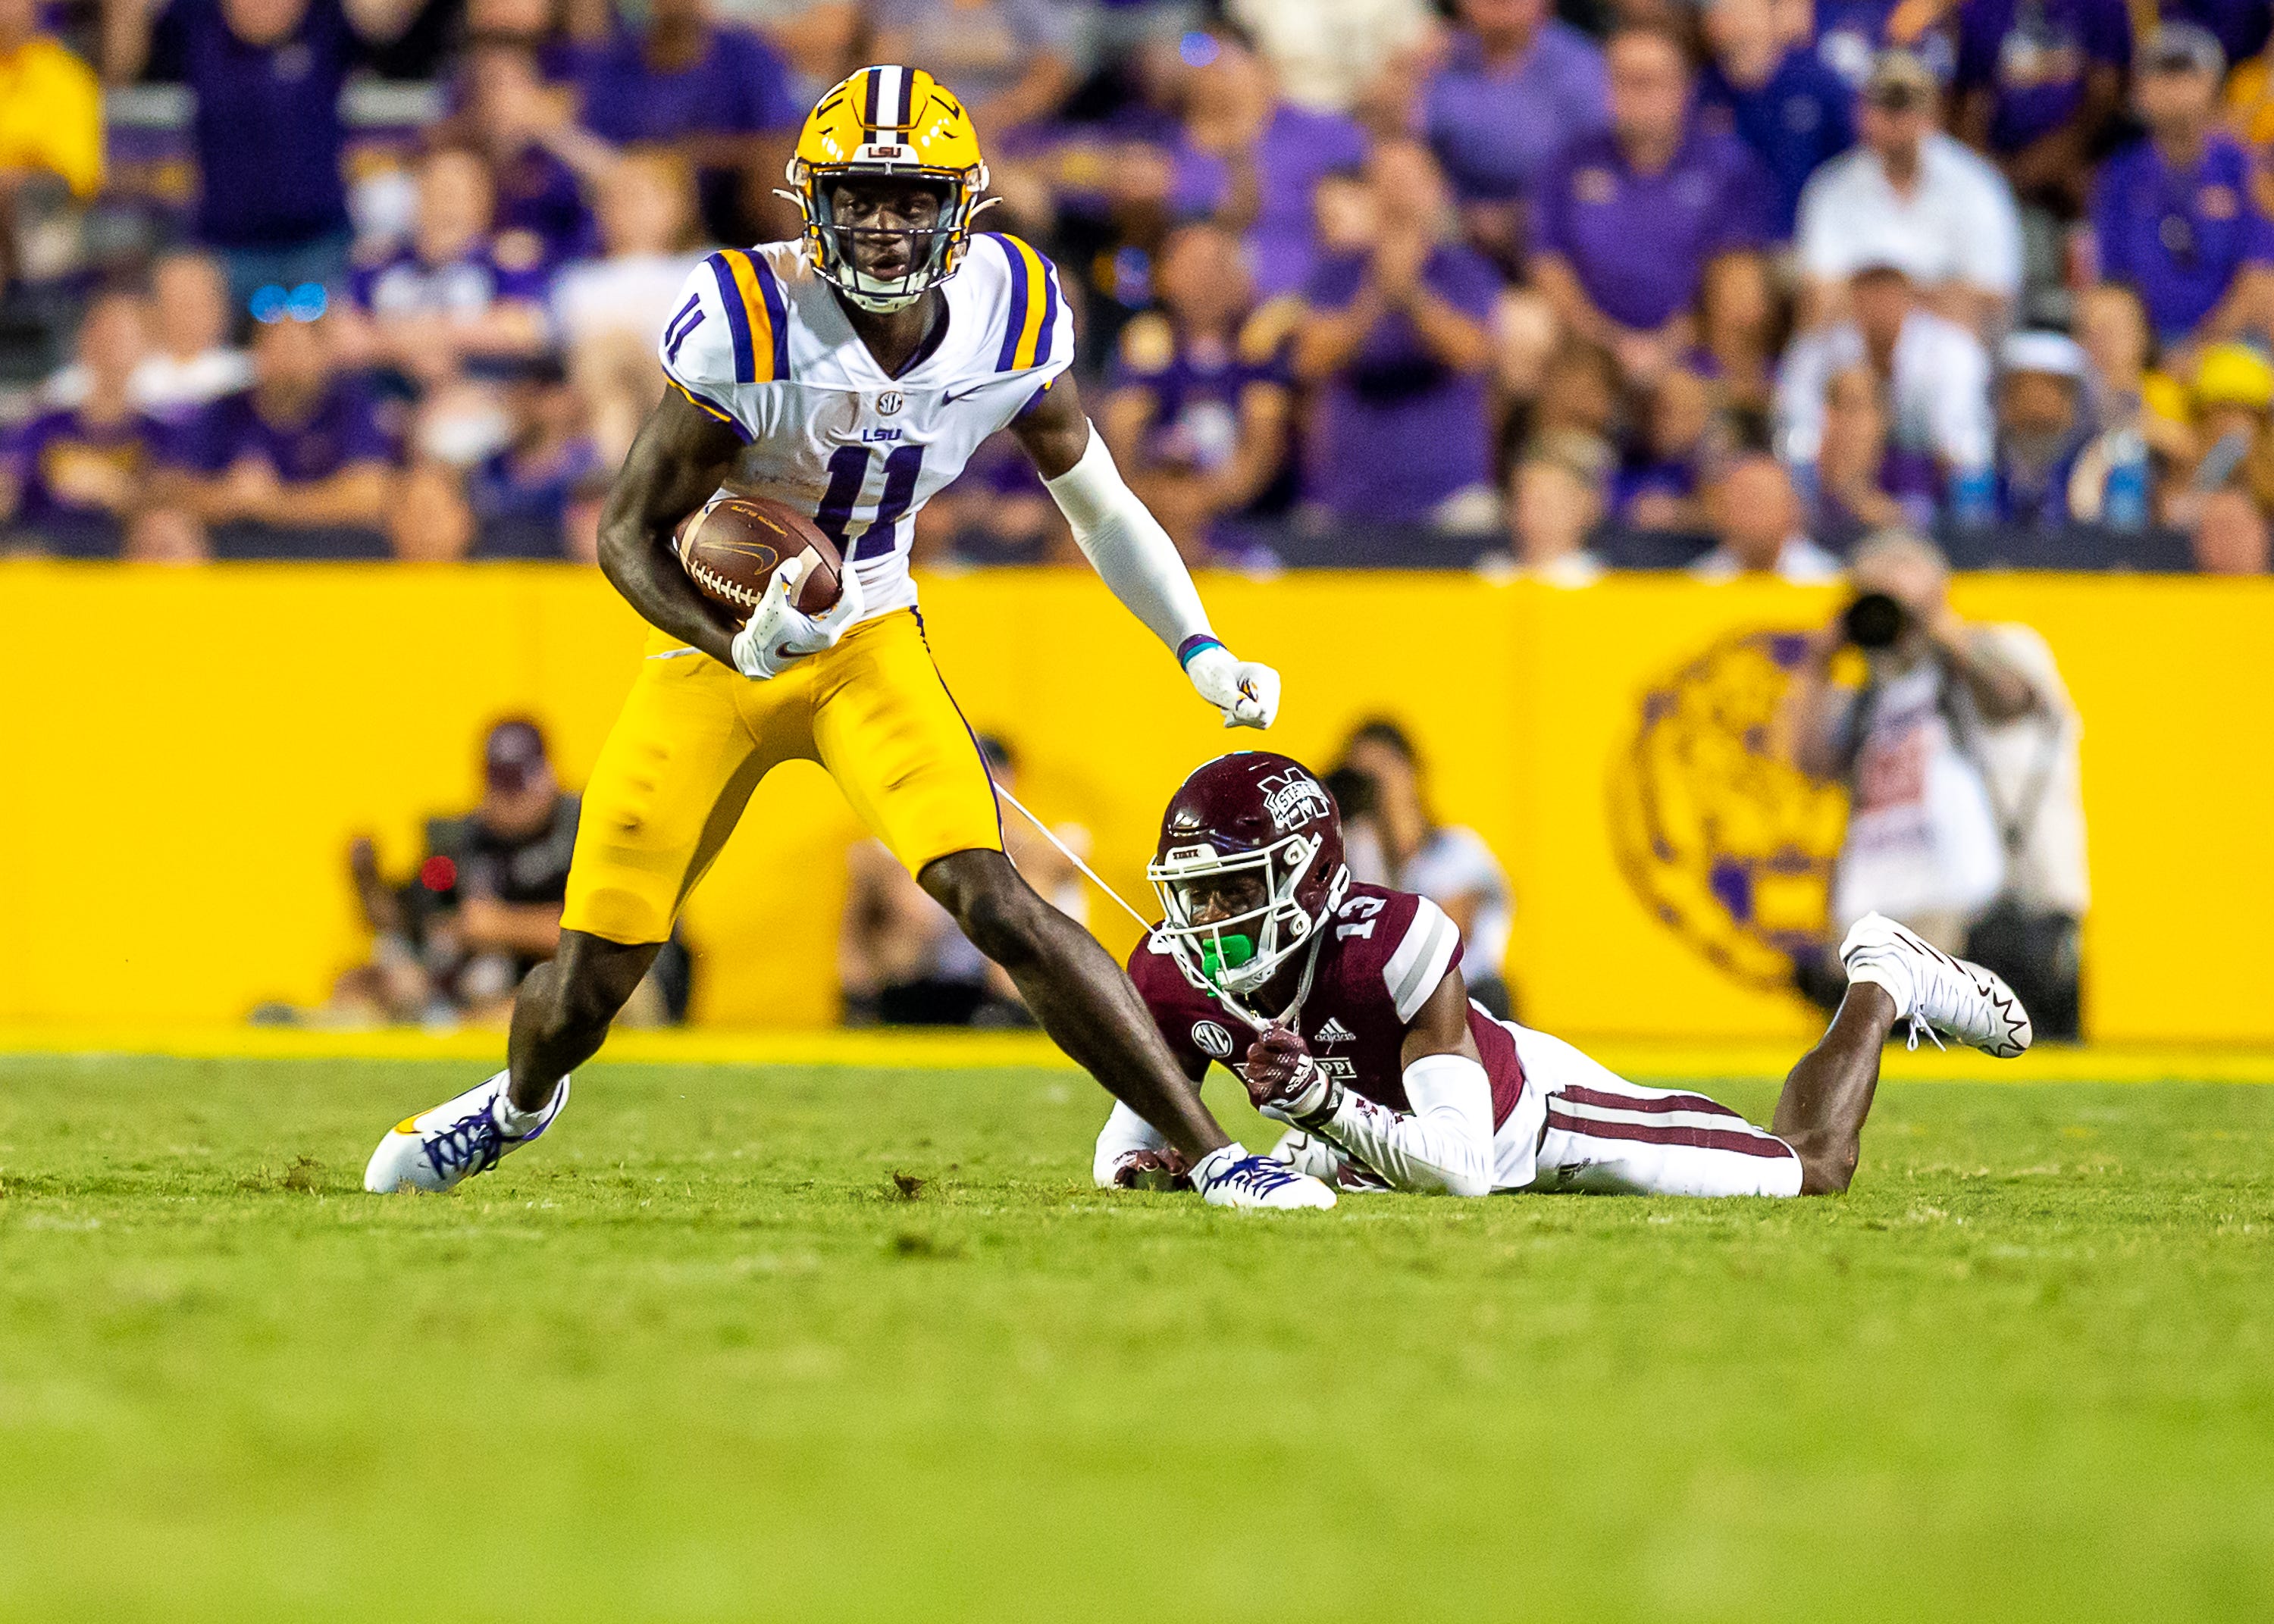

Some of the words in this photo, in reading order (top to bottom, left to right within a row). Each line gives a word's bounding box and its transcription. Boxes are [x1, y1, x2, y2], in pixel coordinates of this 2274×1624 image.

[868, 146, 901, 158] LSU
[665, 293, 706, 366] 11
[863, 428, 902, 442] LSU
[813, 445, 926, 562] 11
[1279, 783, 1317, 809] STATE
[1337, 896, 1387, 941] 13
[1314, 1032, 1357, 1042] adidas
